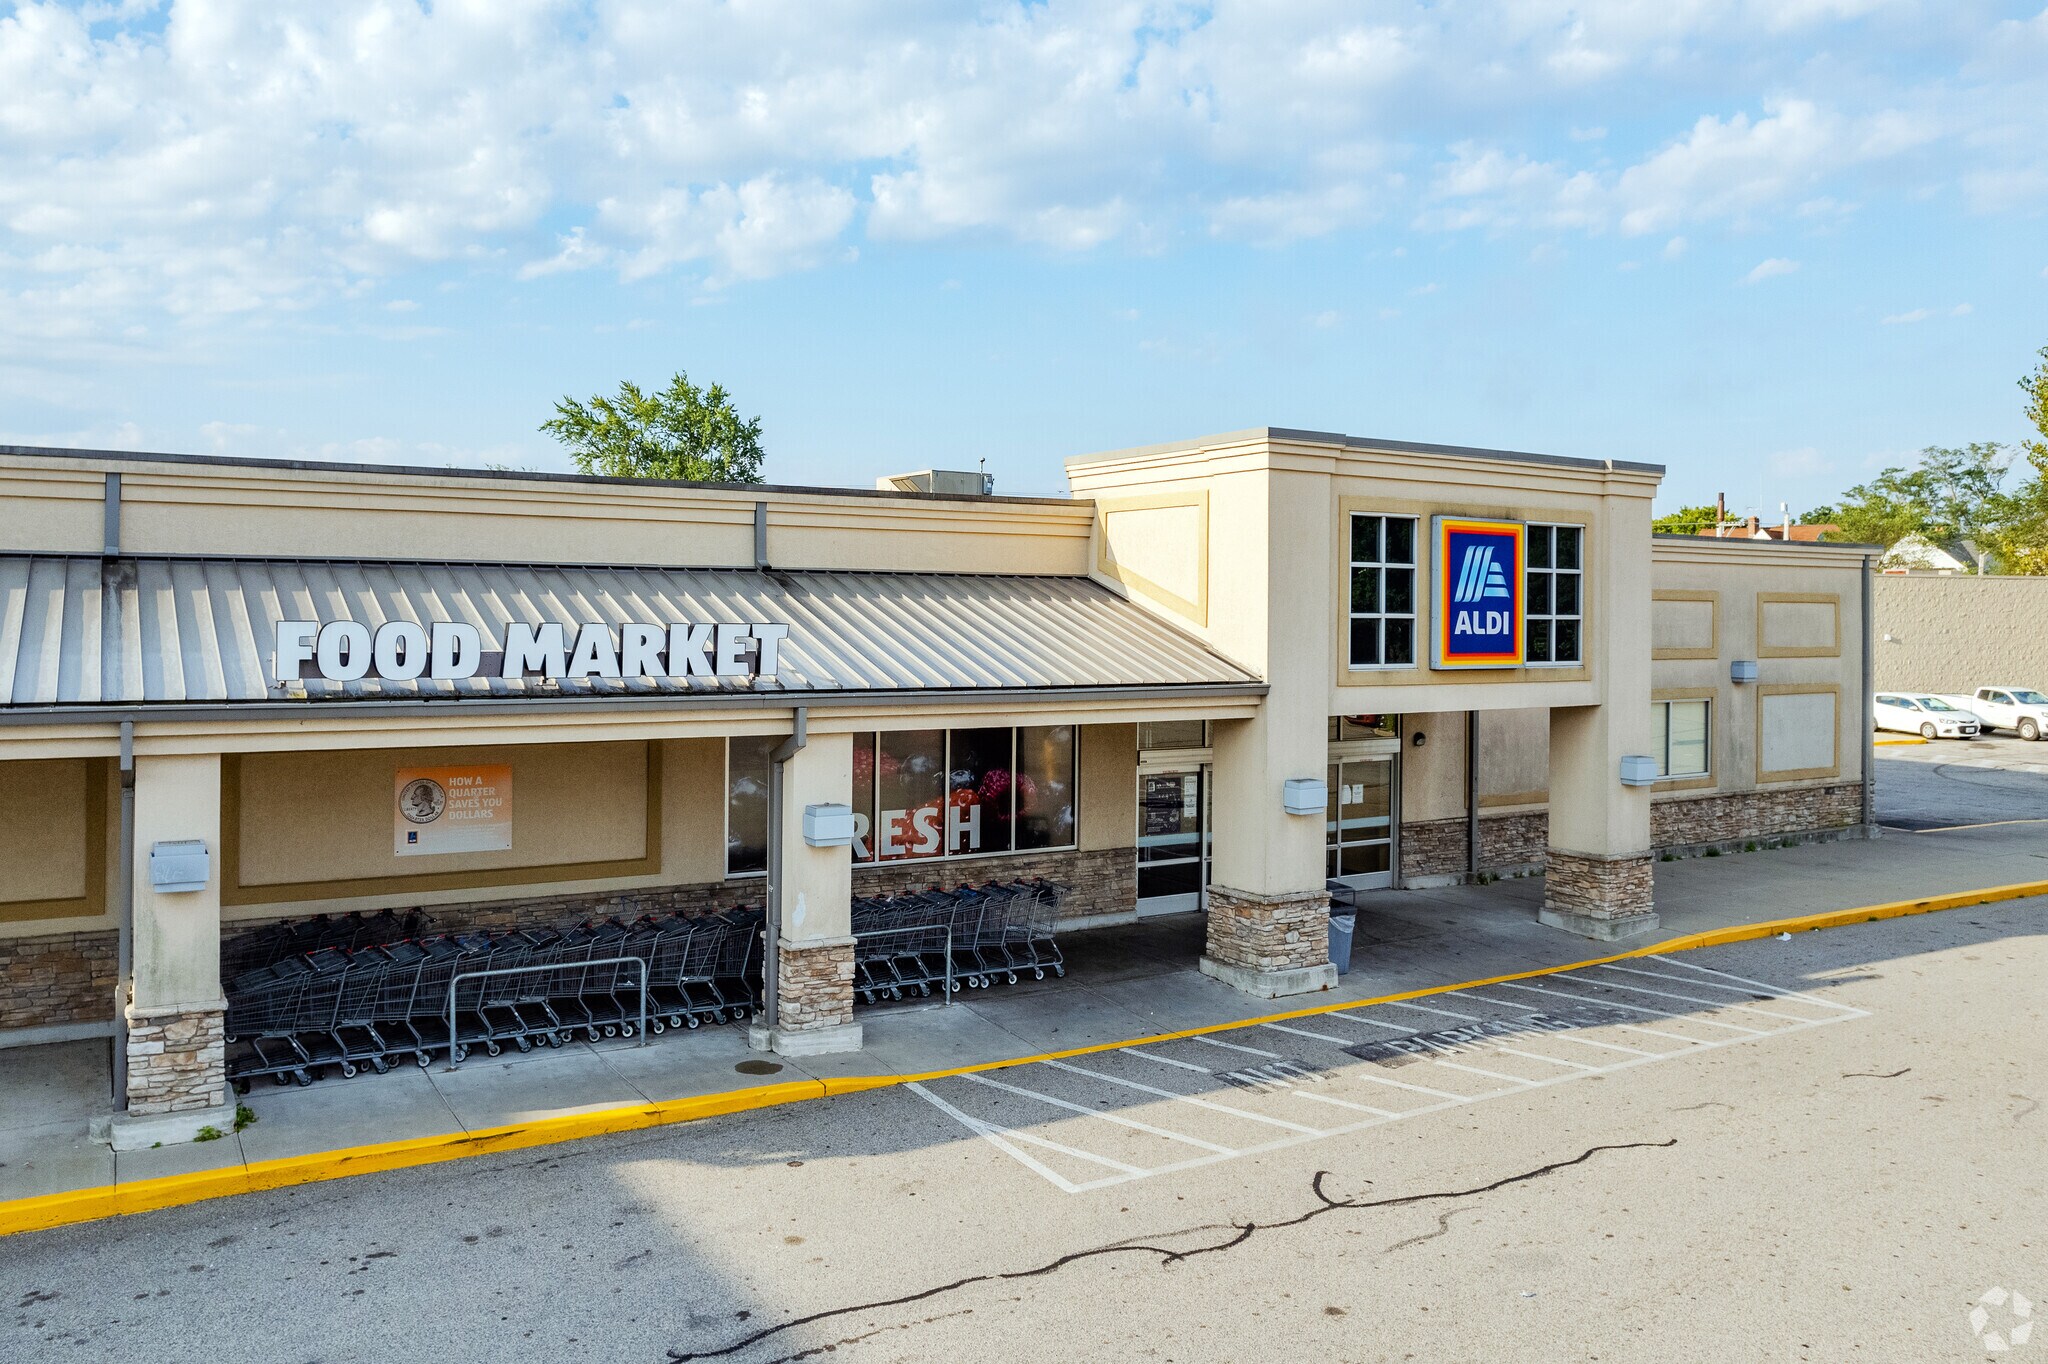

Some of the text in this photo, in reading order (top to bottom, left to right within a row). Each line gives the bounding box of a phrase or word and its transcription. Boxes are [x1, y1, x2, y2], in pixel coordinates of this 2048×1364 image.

[1454, 610, 1510, 635] ALDI
[275, 620, 790, 681] FOOD MARKET
[449, 777, 483, 786] HOW A
[448, 787, 496, 798] QUARTER
[448, 798, 503, 809] SAVES YOU
[448, 810, 494, 820] DOLLARS
